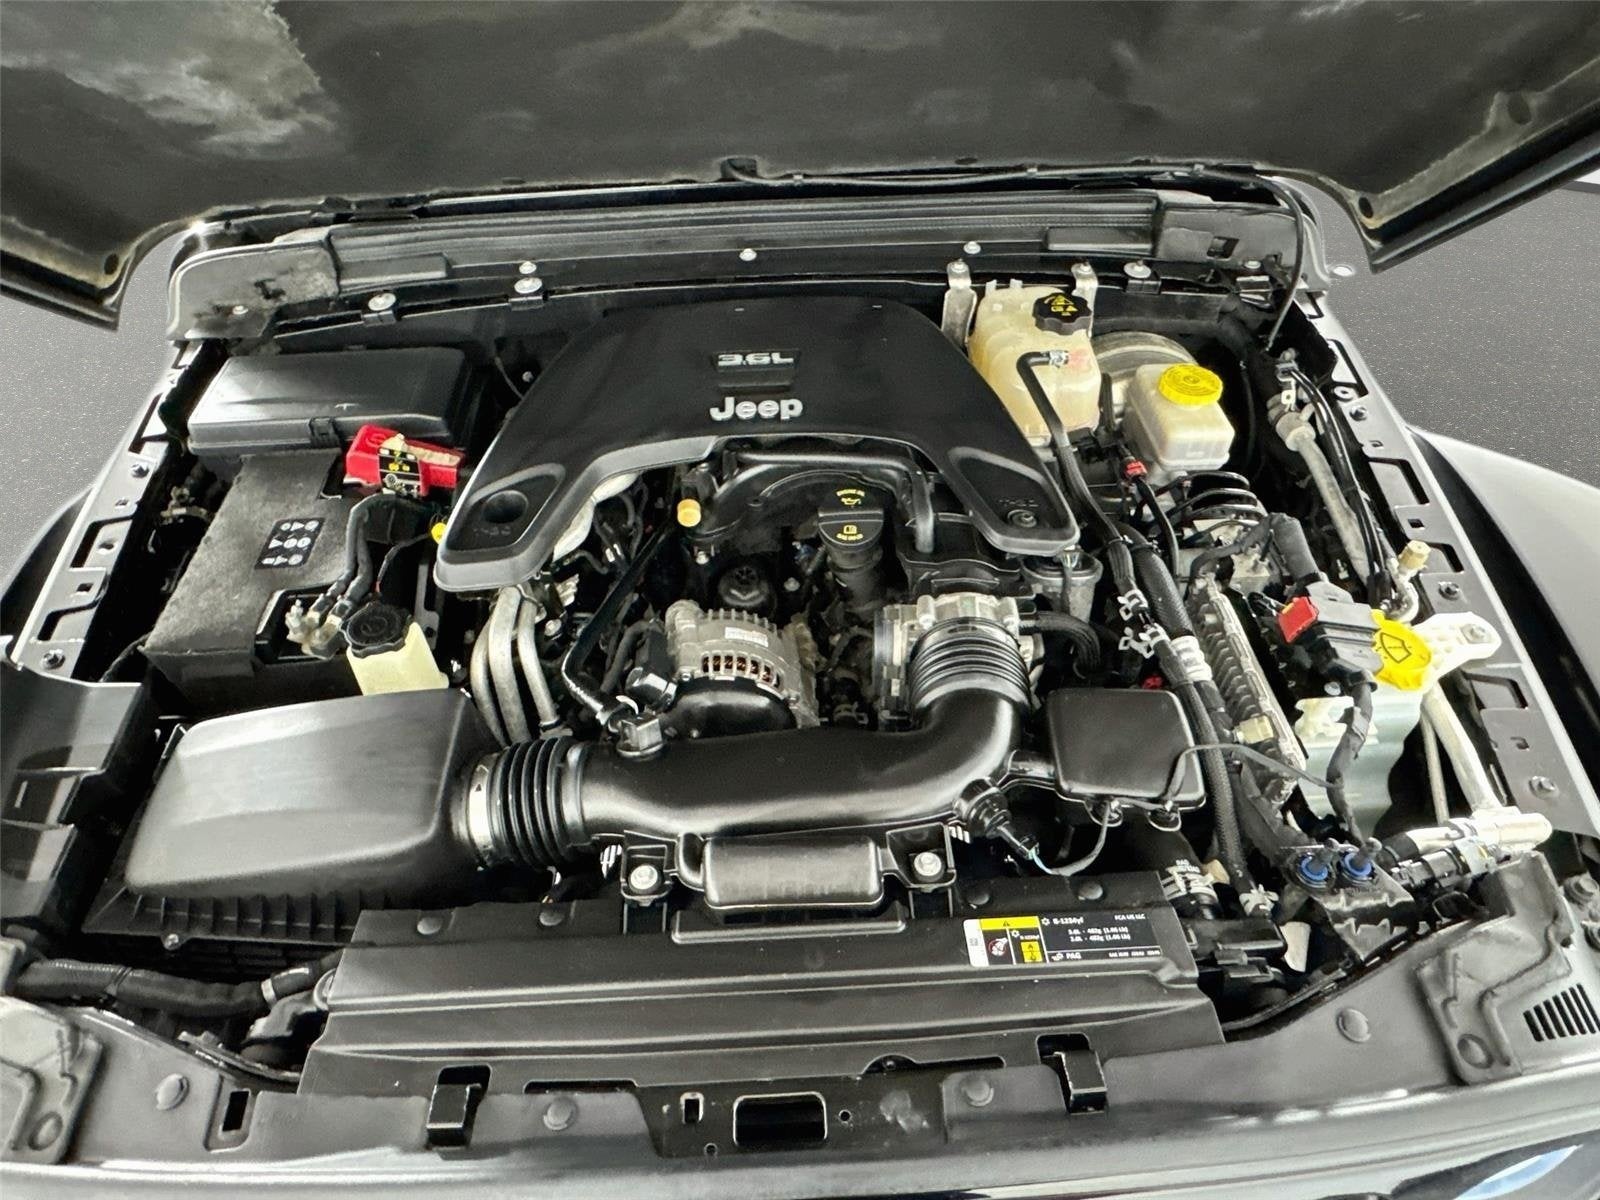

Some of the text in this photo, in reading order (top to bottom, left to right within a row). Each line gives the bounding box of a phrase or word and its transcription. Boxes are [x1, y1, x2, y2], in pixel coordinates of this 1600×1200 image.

[718, 352, 794, 366] 3.6L
[709, 396, 804, 421] Jeep
[1066, 952, 1082, 960] PAG
